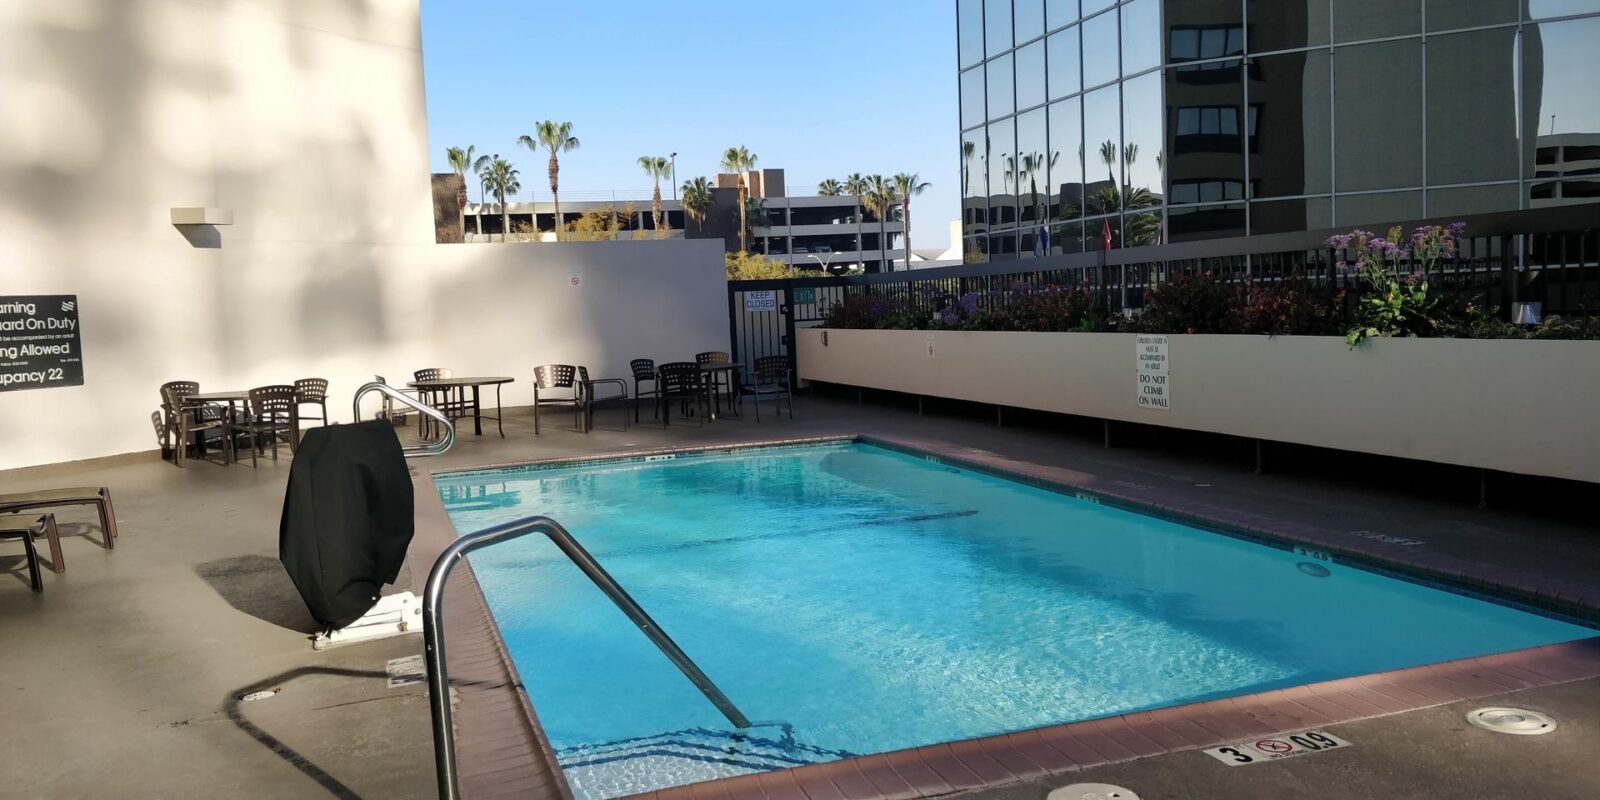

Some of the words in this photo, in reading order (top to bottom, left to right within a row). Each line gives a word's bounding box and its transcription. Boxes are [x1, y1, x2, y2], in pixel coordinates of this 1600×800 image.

[750, 291, 770, 300] KEEP
[746, 300, 775, 308] CLOSED
[0, 318, 25, 331] ard
[26, 317, 46, 330] On
[47, 317, 76, 331] Duty
[20, 342, 70, 356] Allowed
[48, 367, 64, 380] 22
[1140, 374, 1151, 383] DO
[1152, 375, 1166, 384] NOT
[1143, 386, 1163, 395] CLIMB
[1138, 395, 1149, 405] ON
[1150, 397, 1169, 408] WALL
[1289, 732, 1338, 750] 0.9
[1219, 747, 1253, 763] 3
